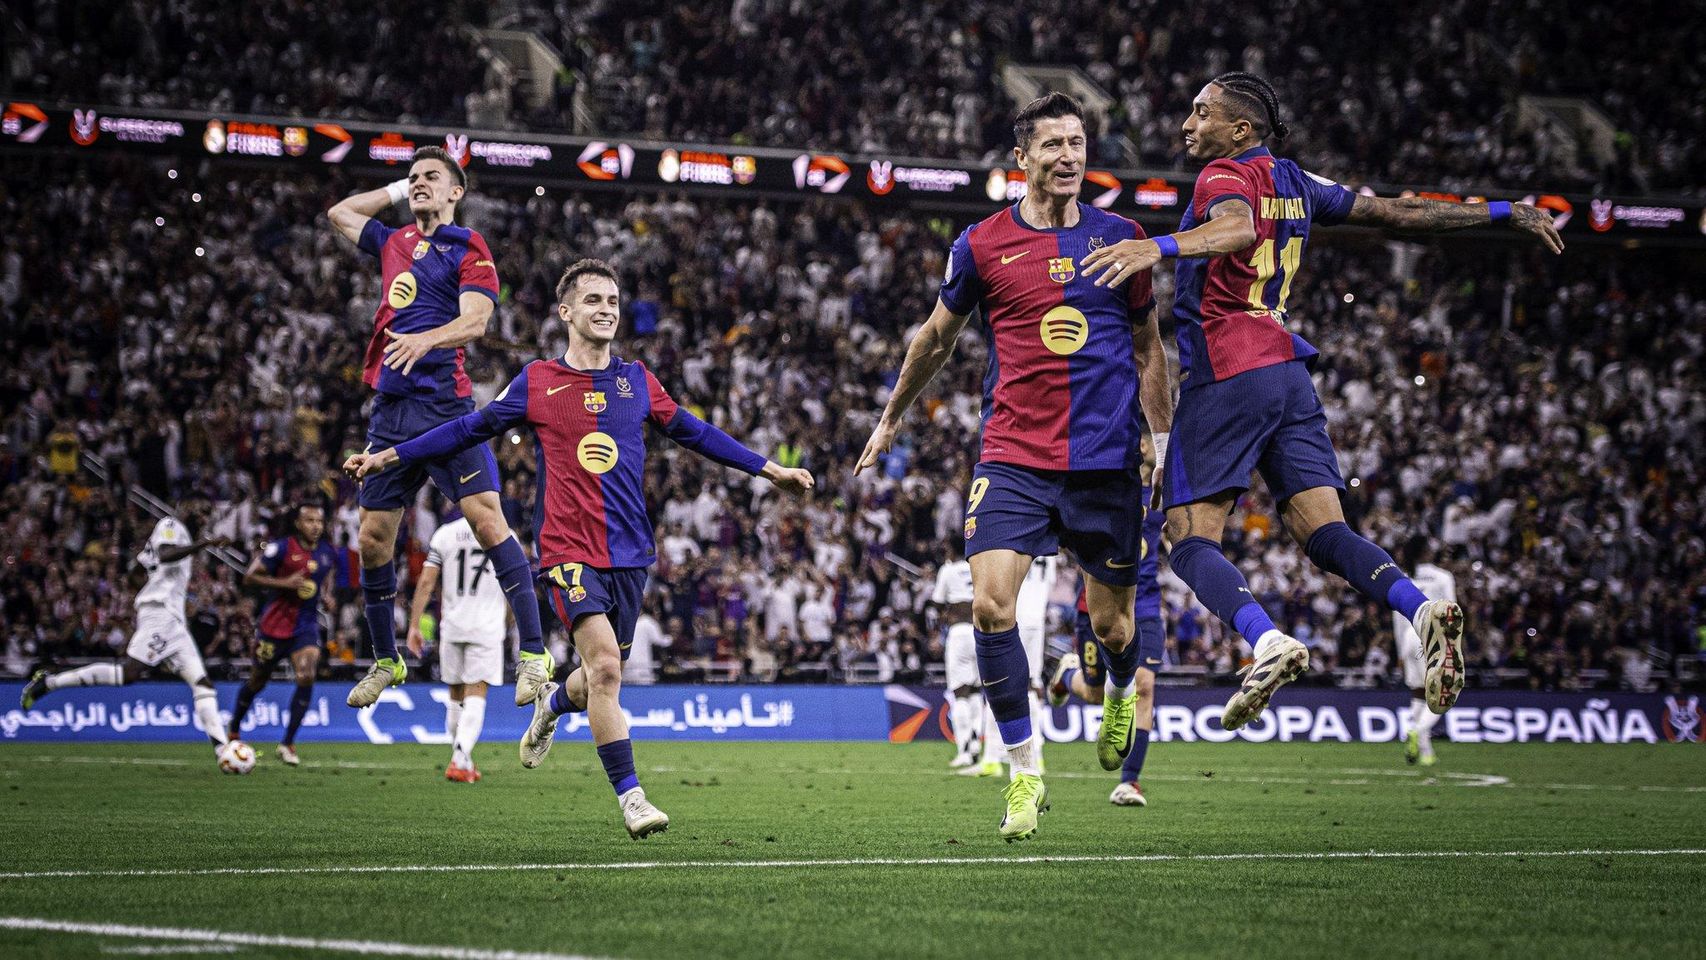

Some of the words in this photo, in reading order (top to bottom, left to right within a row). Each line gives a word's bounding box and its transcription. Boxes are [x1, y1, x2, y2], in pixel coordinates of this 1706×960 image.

[1248, 237, 1304, 313] 11
[967, 477, 990, 514] 9
[456, 547, 491, 597] 17
[548, 562, 583, 592] 17
[1084, 641, 1097, 667] 8
[0, 702, 107, 738] الراجحي
[110, 699, 190, 732] تكافل
[1042, 704, 1352, 743] UPRCOPA
[1445, 698, 1658, 744] ESPAÑA
